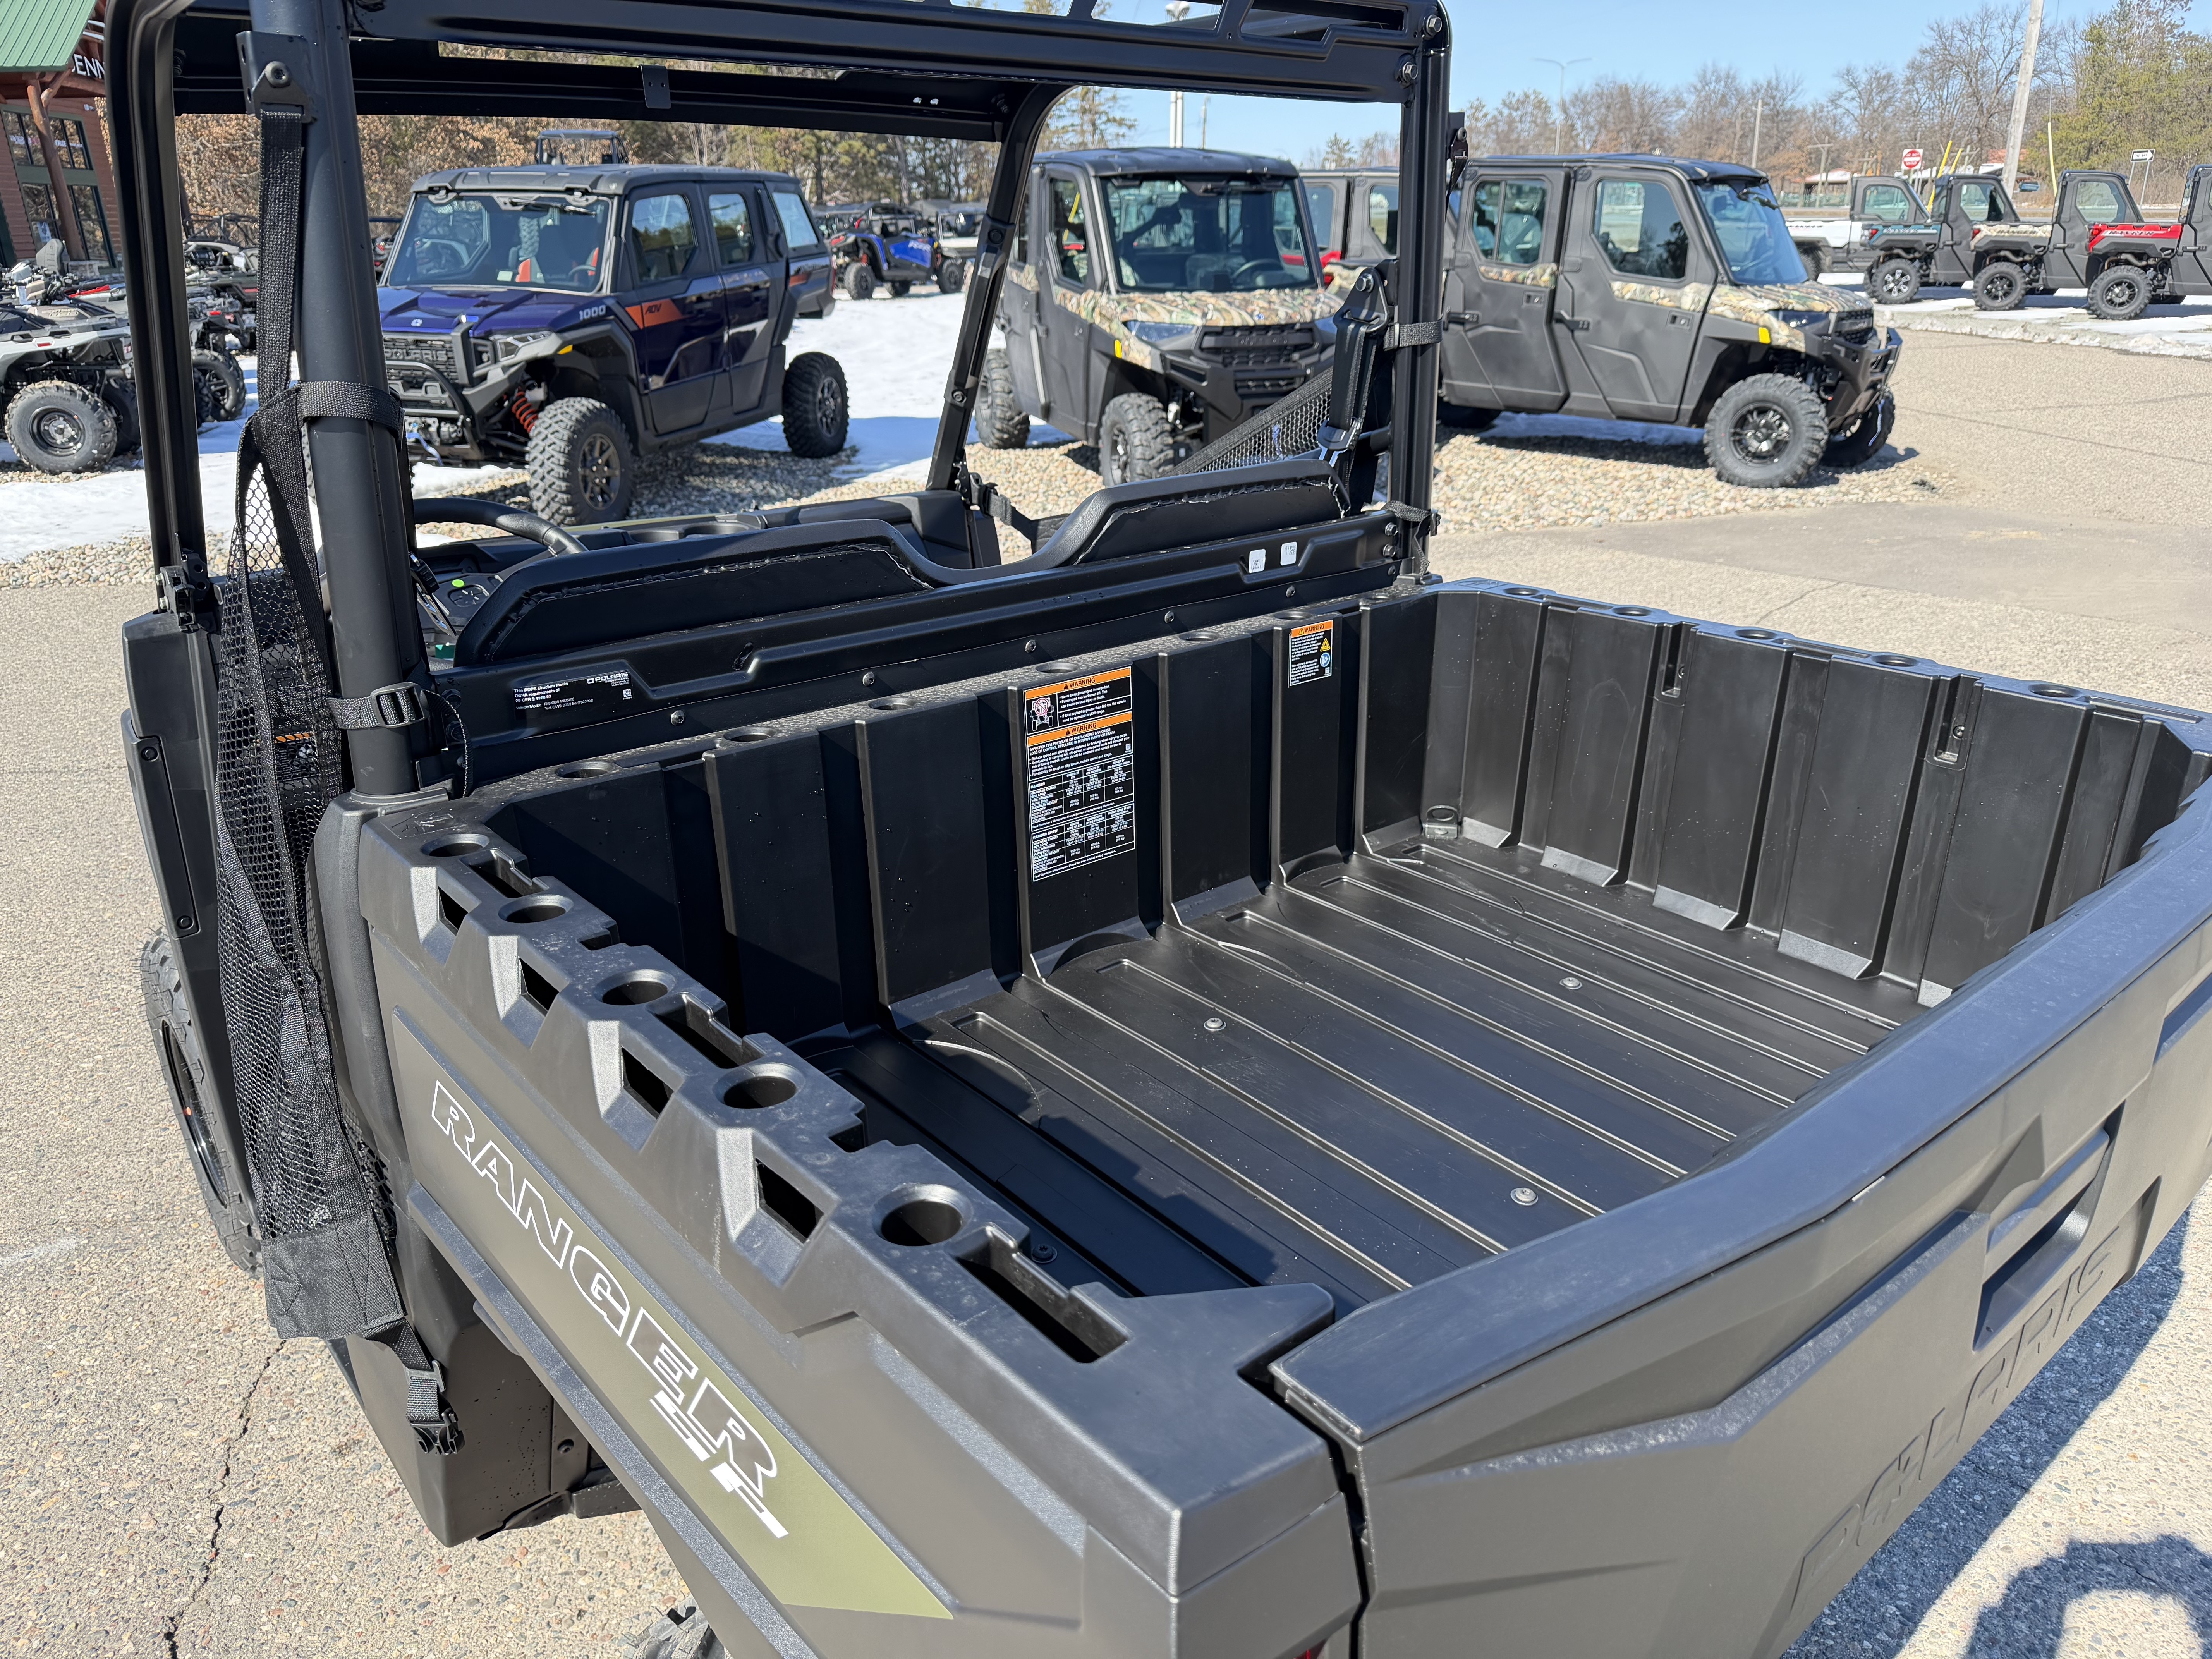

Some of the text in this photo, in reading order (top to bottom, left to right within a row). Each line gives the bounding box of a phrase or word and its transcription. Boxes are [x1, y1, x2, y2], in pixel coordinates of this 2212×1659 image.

[578, 304, 606, 321] 1000
[645, 303, 662, 315] ADV
[385, 348, 448, 361] POLARIS
[1304, 624, 1324, 633] WARNING
[595, 672, 629, 682] POLARIS
[1070, 677, 1095, 687] WARNING
[1072, 723, 1096, 732] WARNING
[430, 1080, 778, 1498] RANGER
[1789, 1226, 2120, 1611] POLARIS
[649, 1389, 789, 1538] SP
